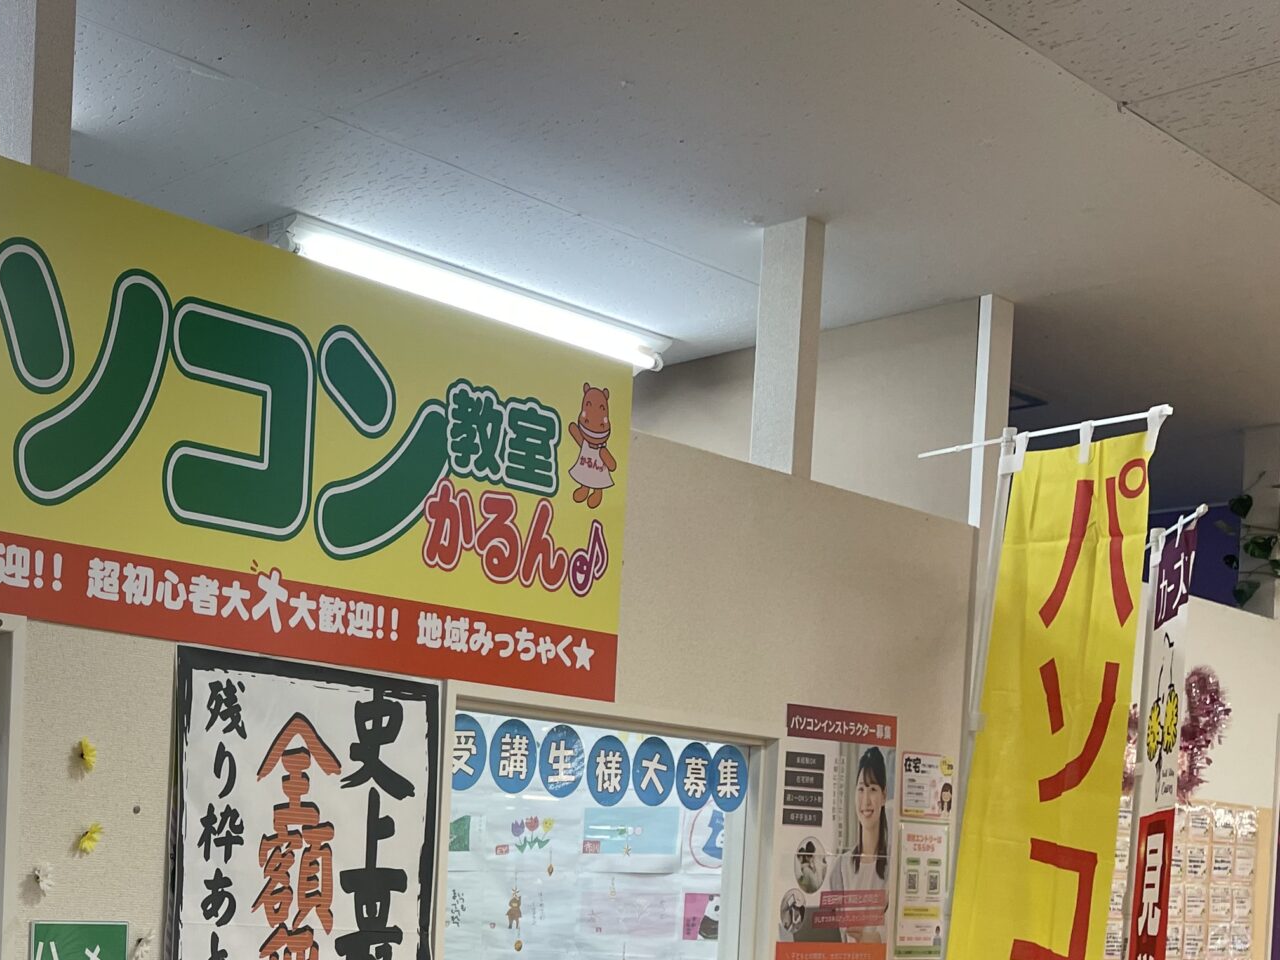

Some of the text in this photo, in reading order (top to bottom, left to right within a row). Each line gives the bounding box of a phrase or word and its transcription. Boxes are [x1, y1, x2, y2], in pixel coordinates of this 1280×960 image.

[445, 377, 561, 497] 教室
[452, 730, 742, 800] 受講生様大募集
